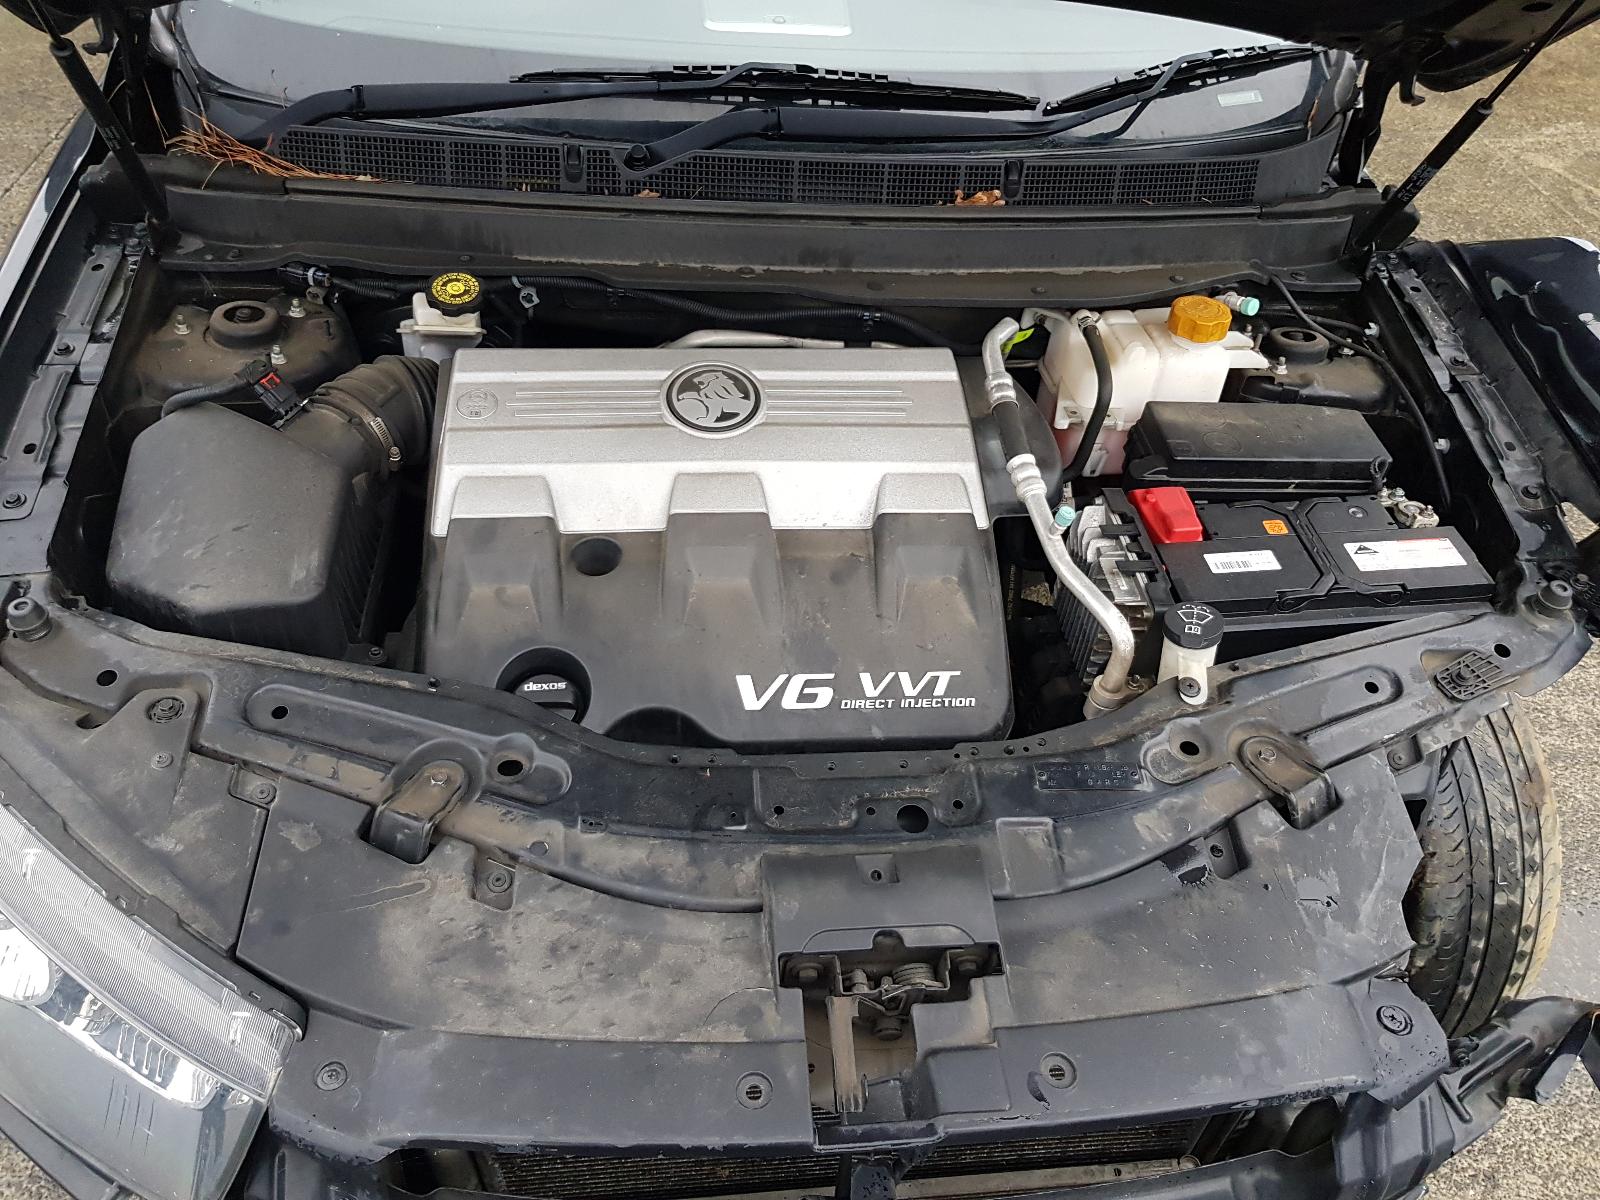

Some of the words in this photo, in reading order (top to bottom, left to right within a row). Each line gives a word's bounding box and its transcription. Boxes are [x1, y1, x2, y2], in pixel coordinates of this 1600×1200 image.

[524, 681, 567, 691] dexos
[735, 673, 835, 711] V6
[859, 670, 961, 697] VVT
[841, 699, 895, 709] DIRECT
[900, 697, 976, 709] INJECTION
